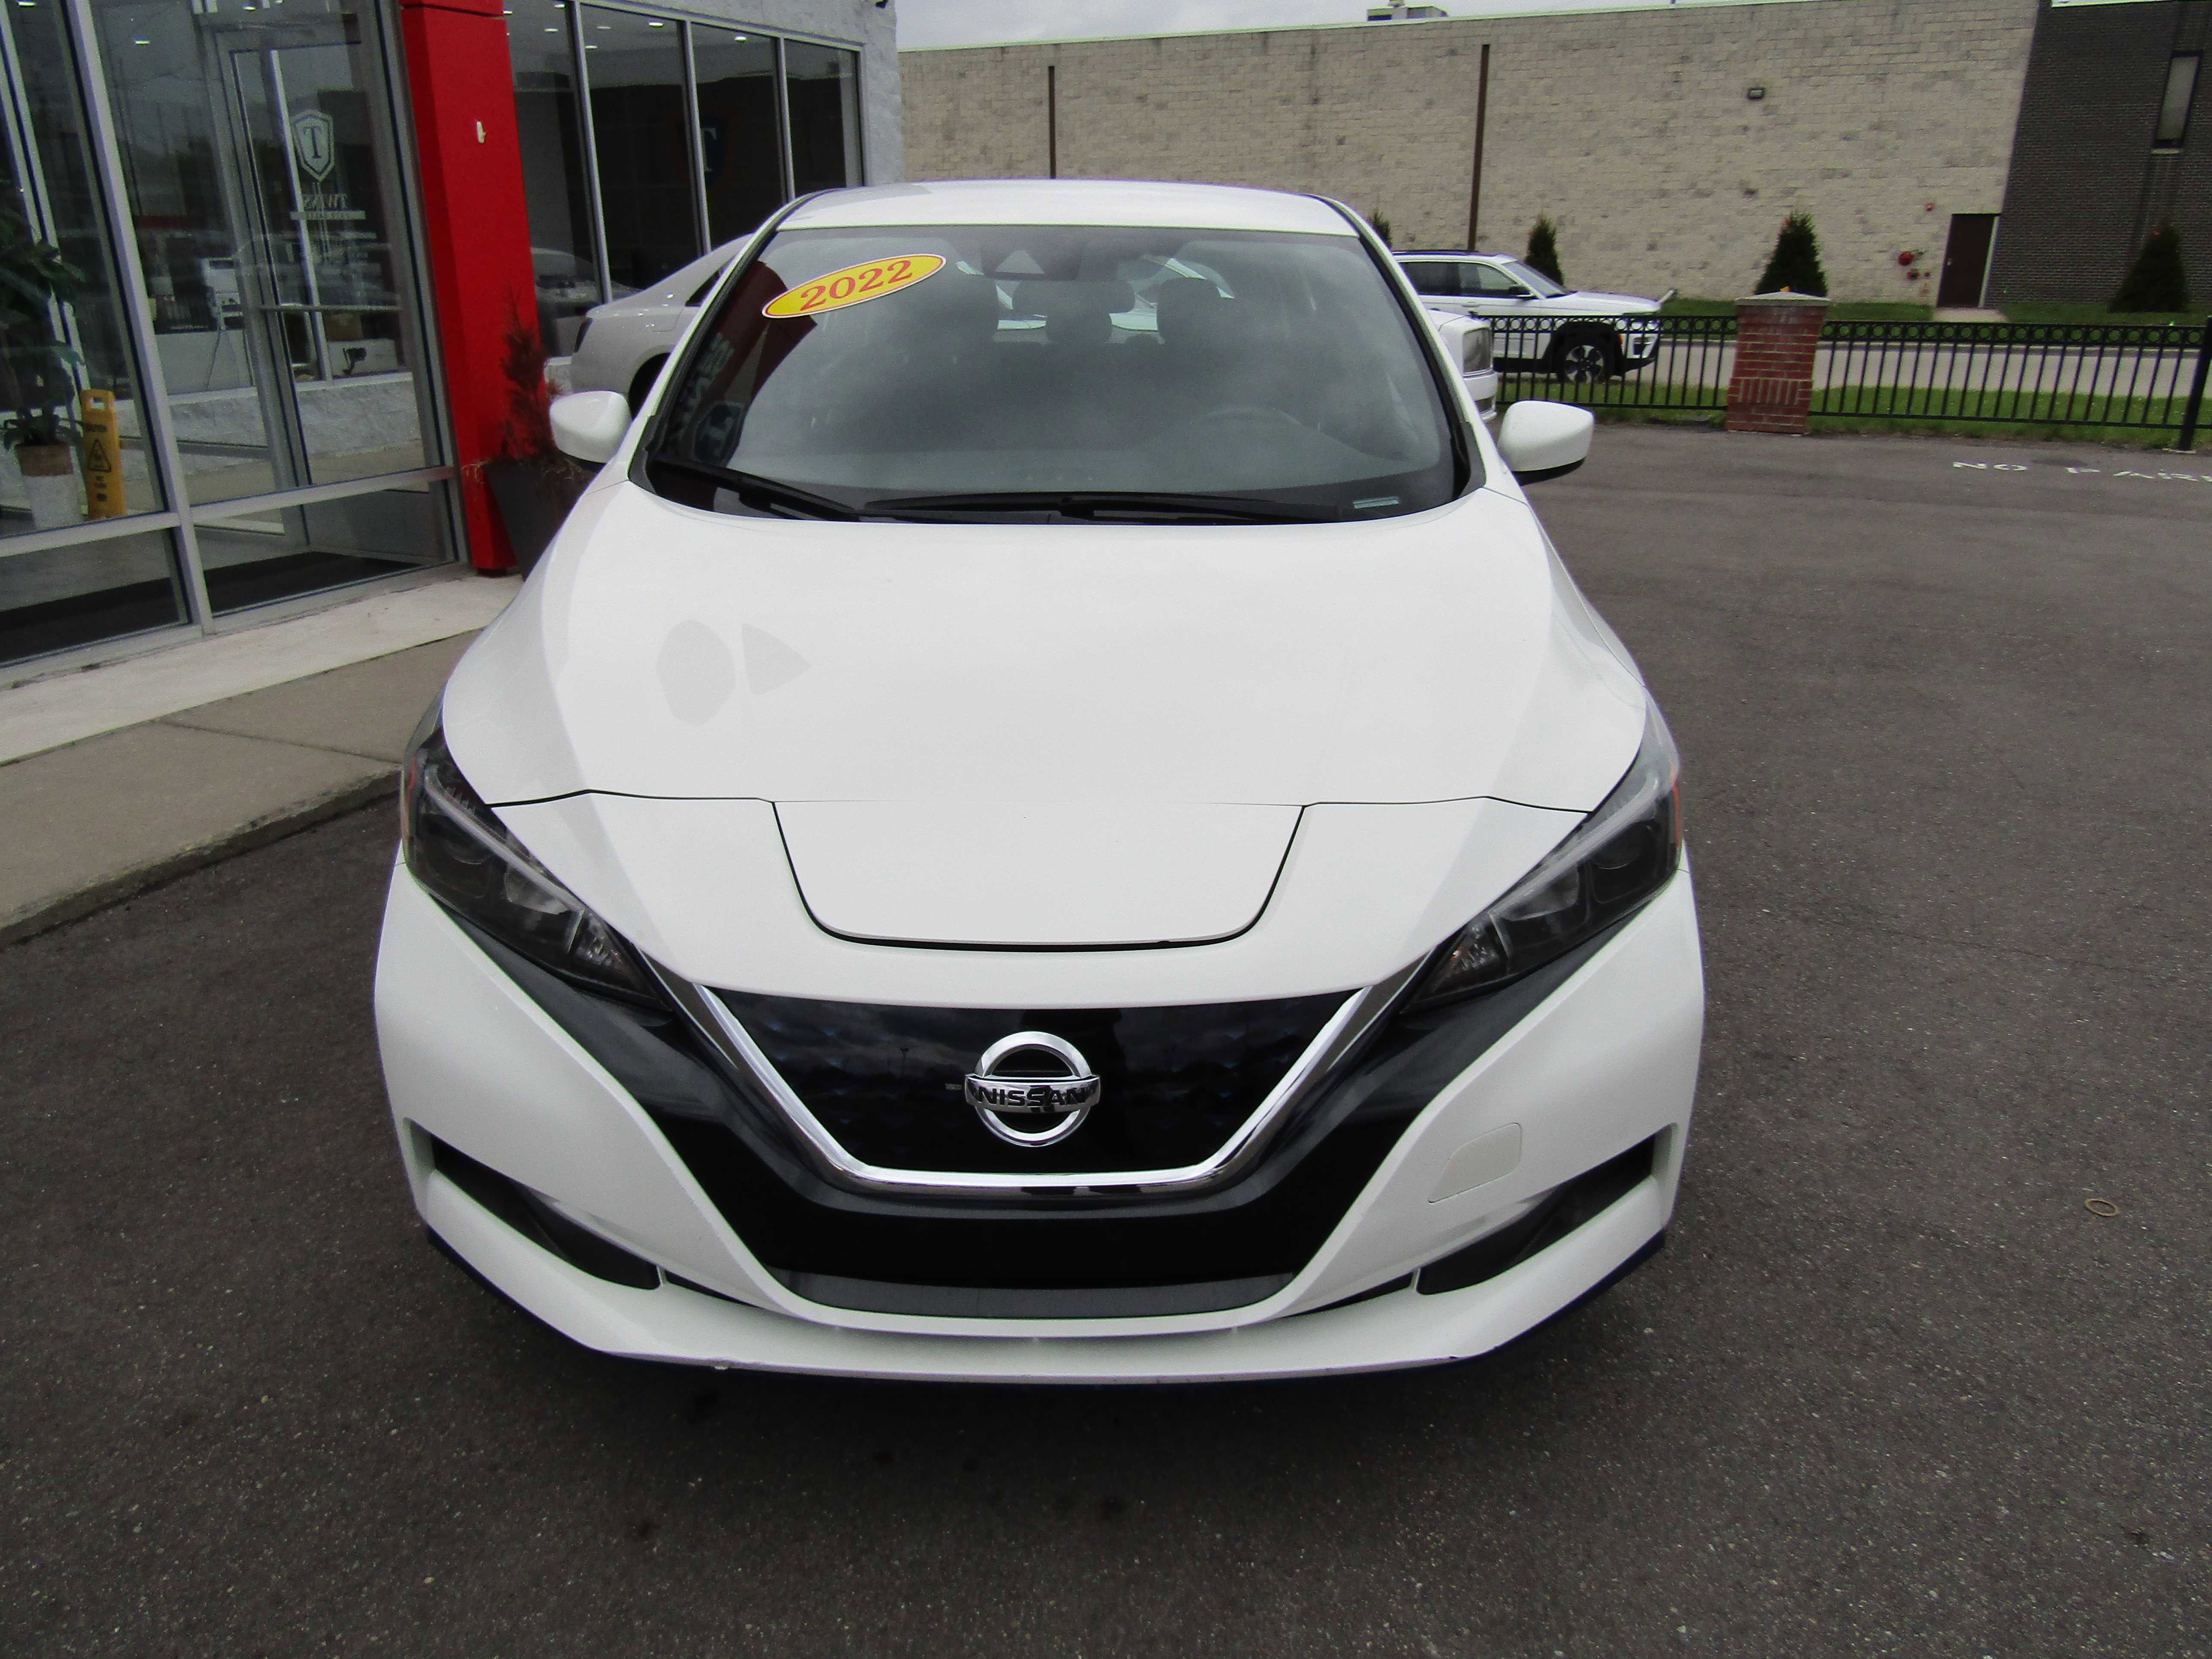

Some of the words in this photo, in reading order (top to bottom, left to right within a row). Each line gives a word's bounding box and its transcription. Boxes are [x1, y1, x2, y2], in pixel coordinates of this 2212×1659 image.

[800, 260, 912, 311] 2022
[1953, 462, 2028, 471] NO
[2066, 467, 2212, 483] PAR
[976, 1086, 1088, 1106] NISSAN
